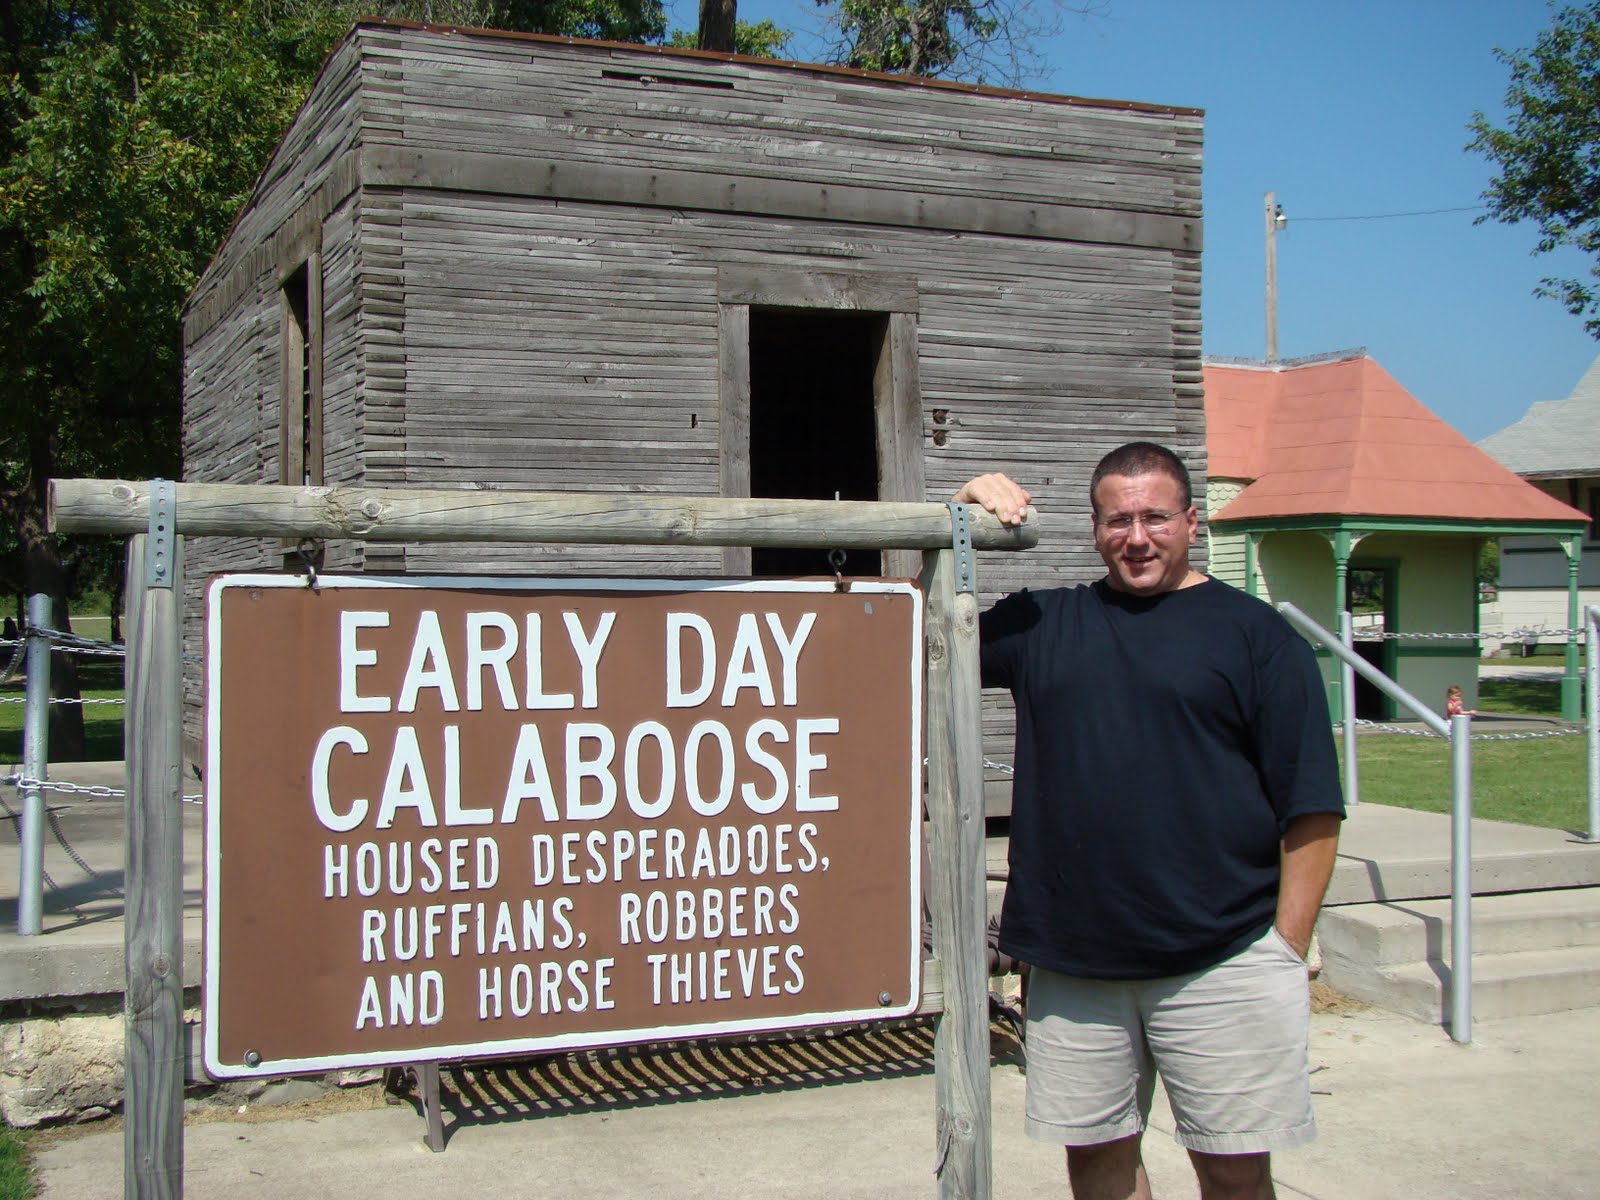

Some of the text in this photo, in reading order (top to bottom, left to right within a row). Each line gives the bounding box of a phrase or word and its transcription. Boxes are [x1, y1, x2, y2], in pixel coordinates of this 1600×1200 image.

[338, 608, 818, 714] EARLY DAY
[310, 716, 841, 832] CALABOOSE
[323, 822, 831, 898] HOUSED DESPERADOES,
[361, 883, 801, 963] RUFFIANS, ROBBERS
[355, 943, 806, 1031] AND HORSE THIEVES
